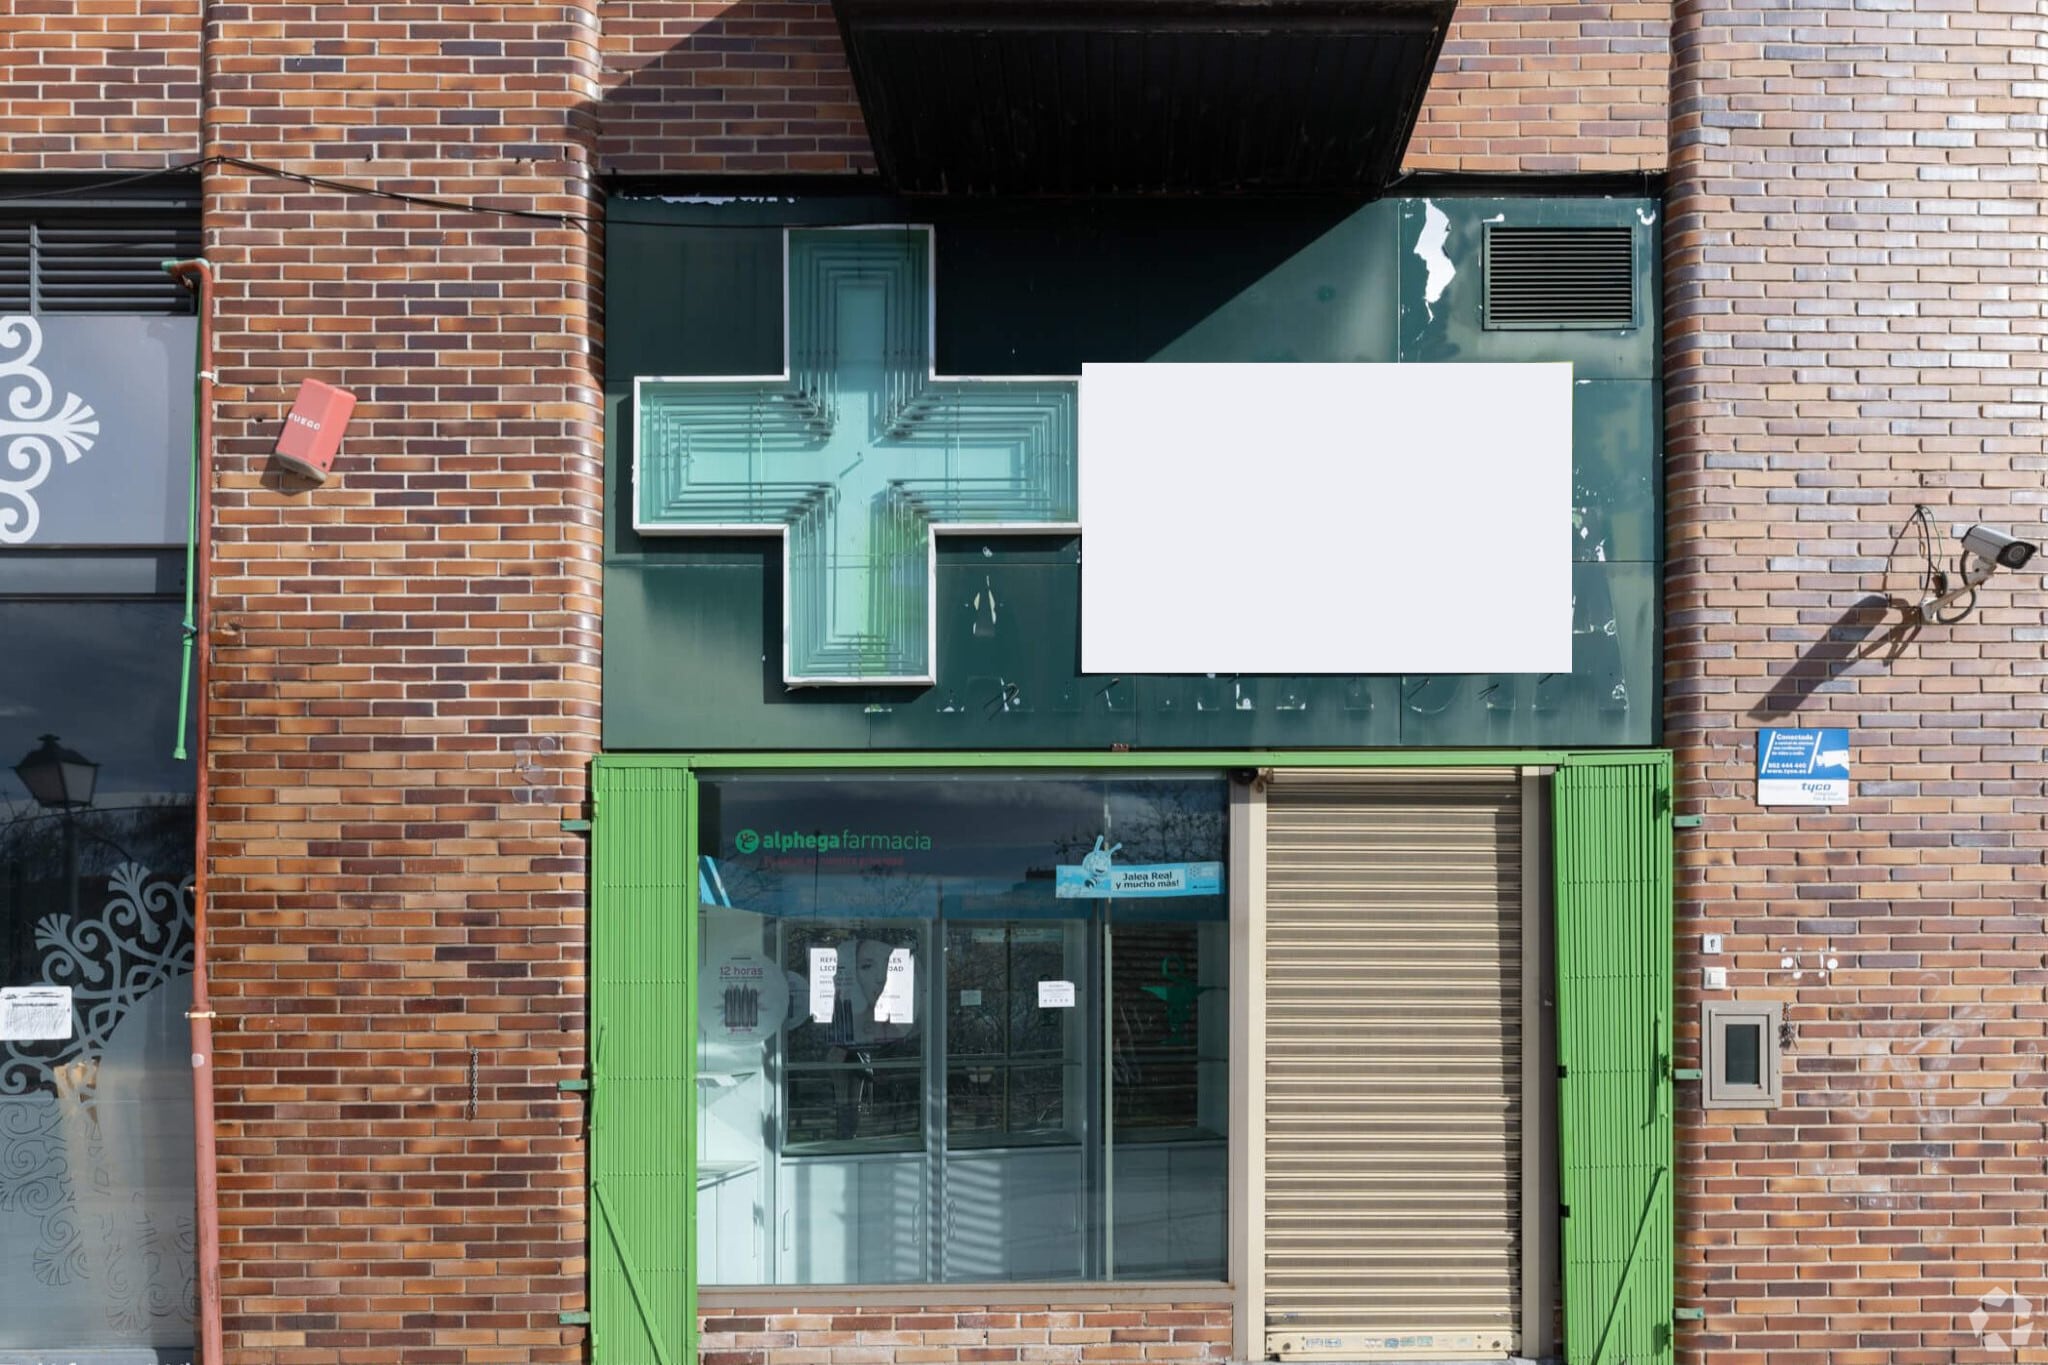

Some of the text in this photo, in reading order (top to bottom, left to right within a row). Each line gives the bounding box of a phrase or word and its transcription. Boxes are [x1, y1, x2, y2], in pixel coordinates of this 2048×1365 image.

[288, 412, 321, 431] FUEGO
[1801, 782, 1831, 792] tyco
[1122, 872, 1173, 881] Jalea Real
[1124, 880, 1155, 888] mucho
[720, 966, 763, 976] 12 horas
